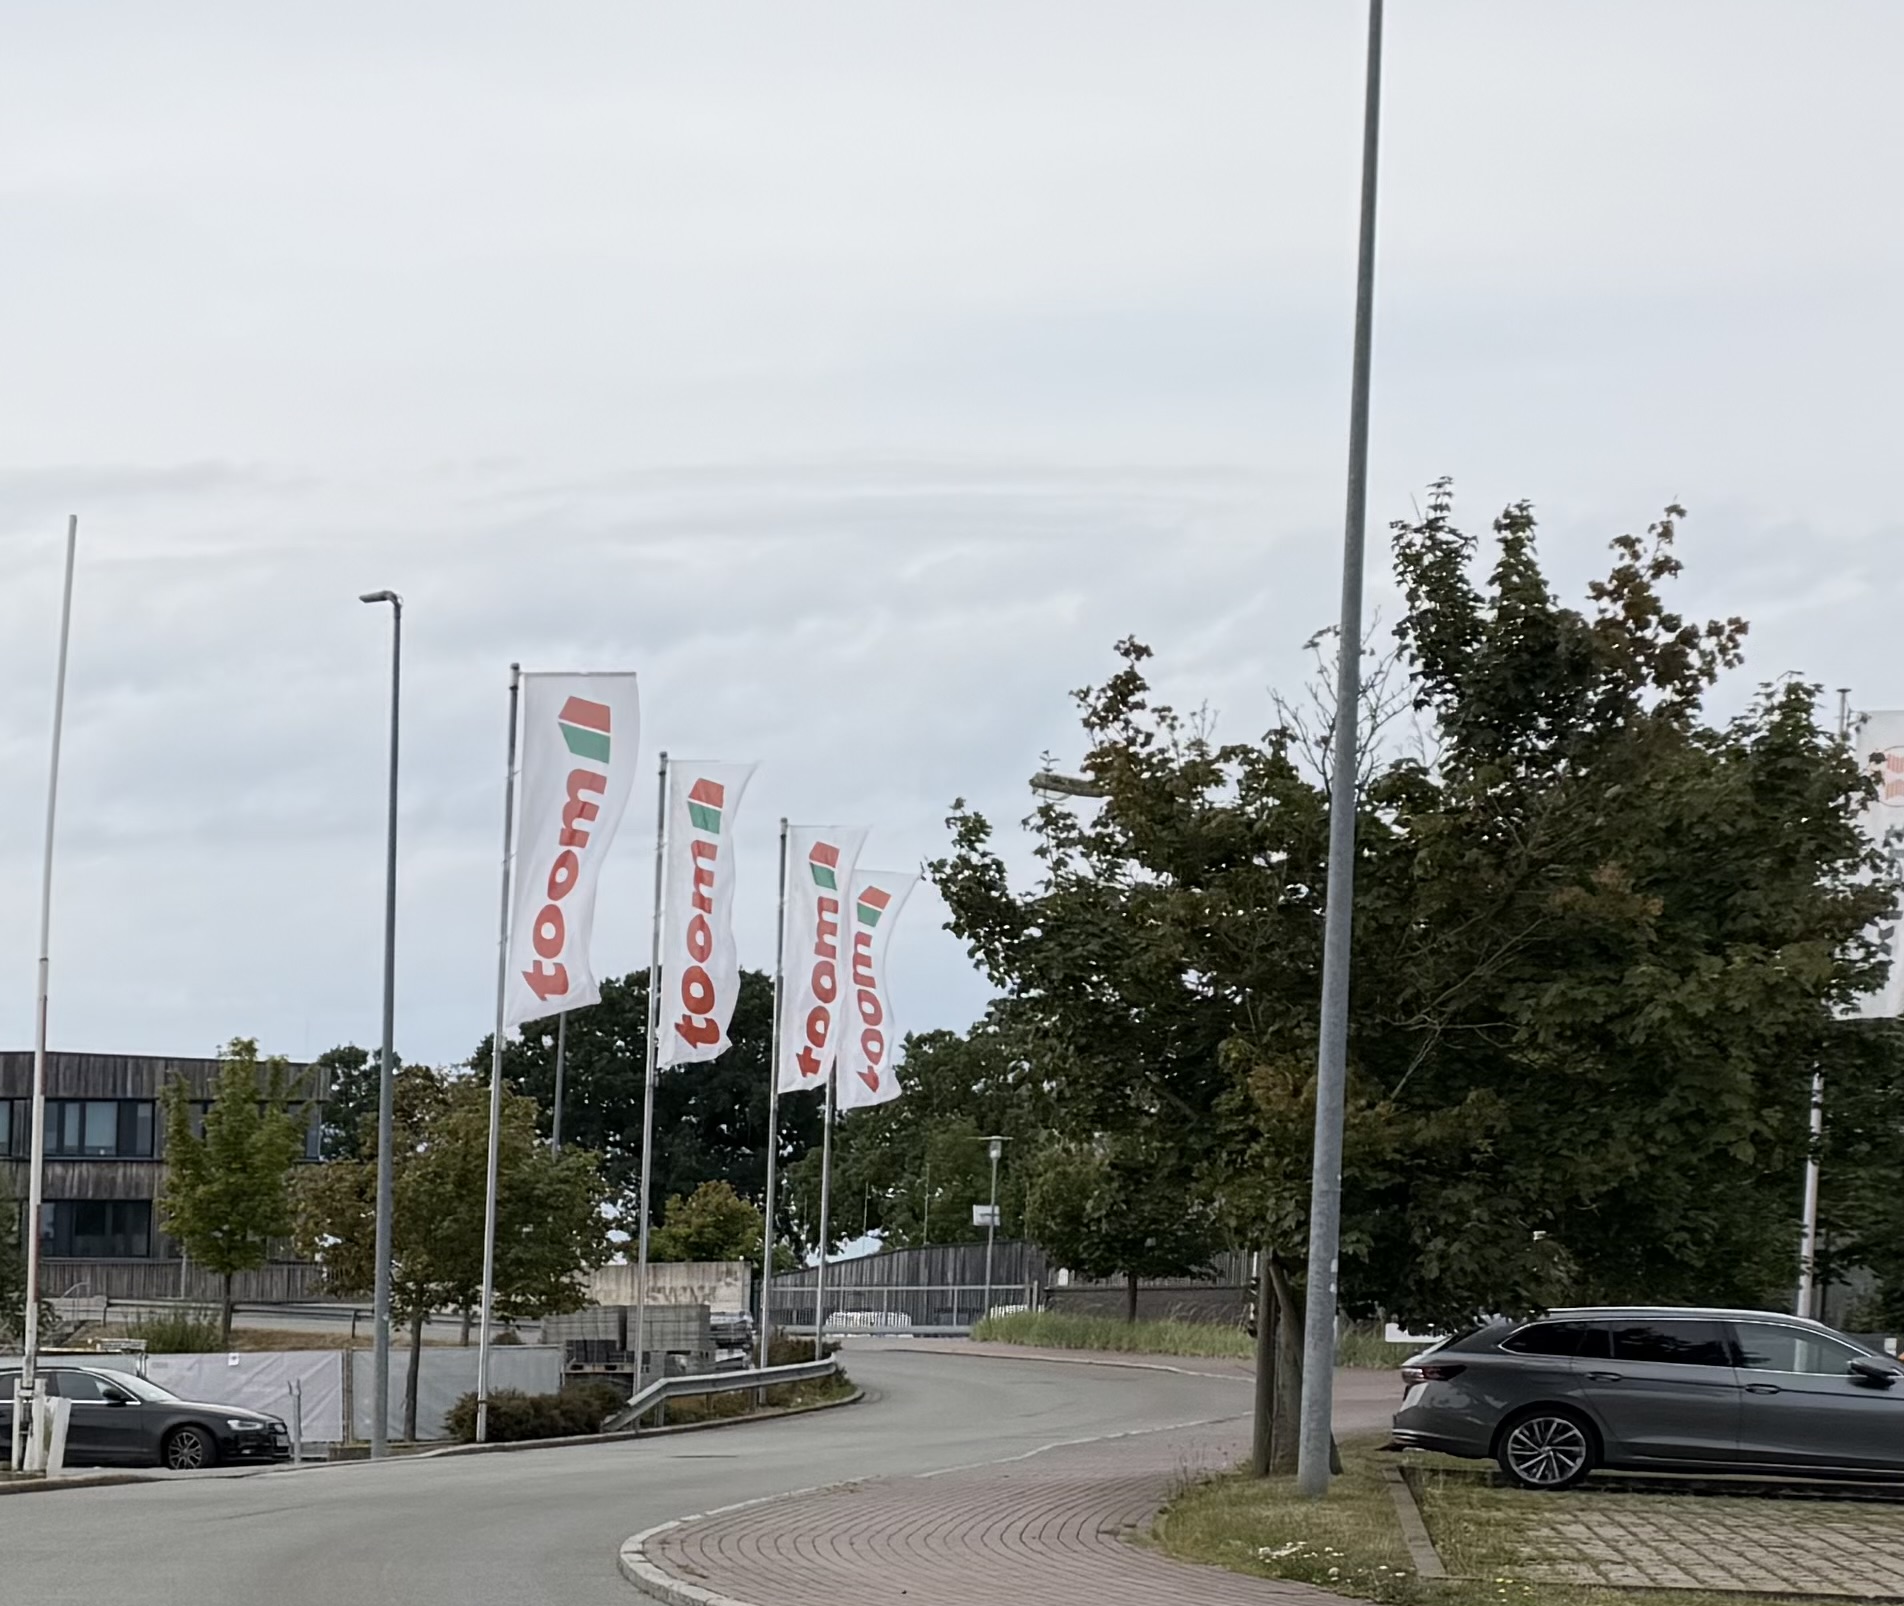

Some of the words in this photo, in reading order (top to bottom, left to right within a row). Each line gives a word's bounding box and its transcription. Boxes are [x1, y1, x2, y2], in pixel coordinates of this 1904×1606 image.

[522, 768, 608, 1001] toom
[674, 839, 721, 1049] toom
[796, 896, 840, 1077] toom
[852, 931, 885, 1093] toom
